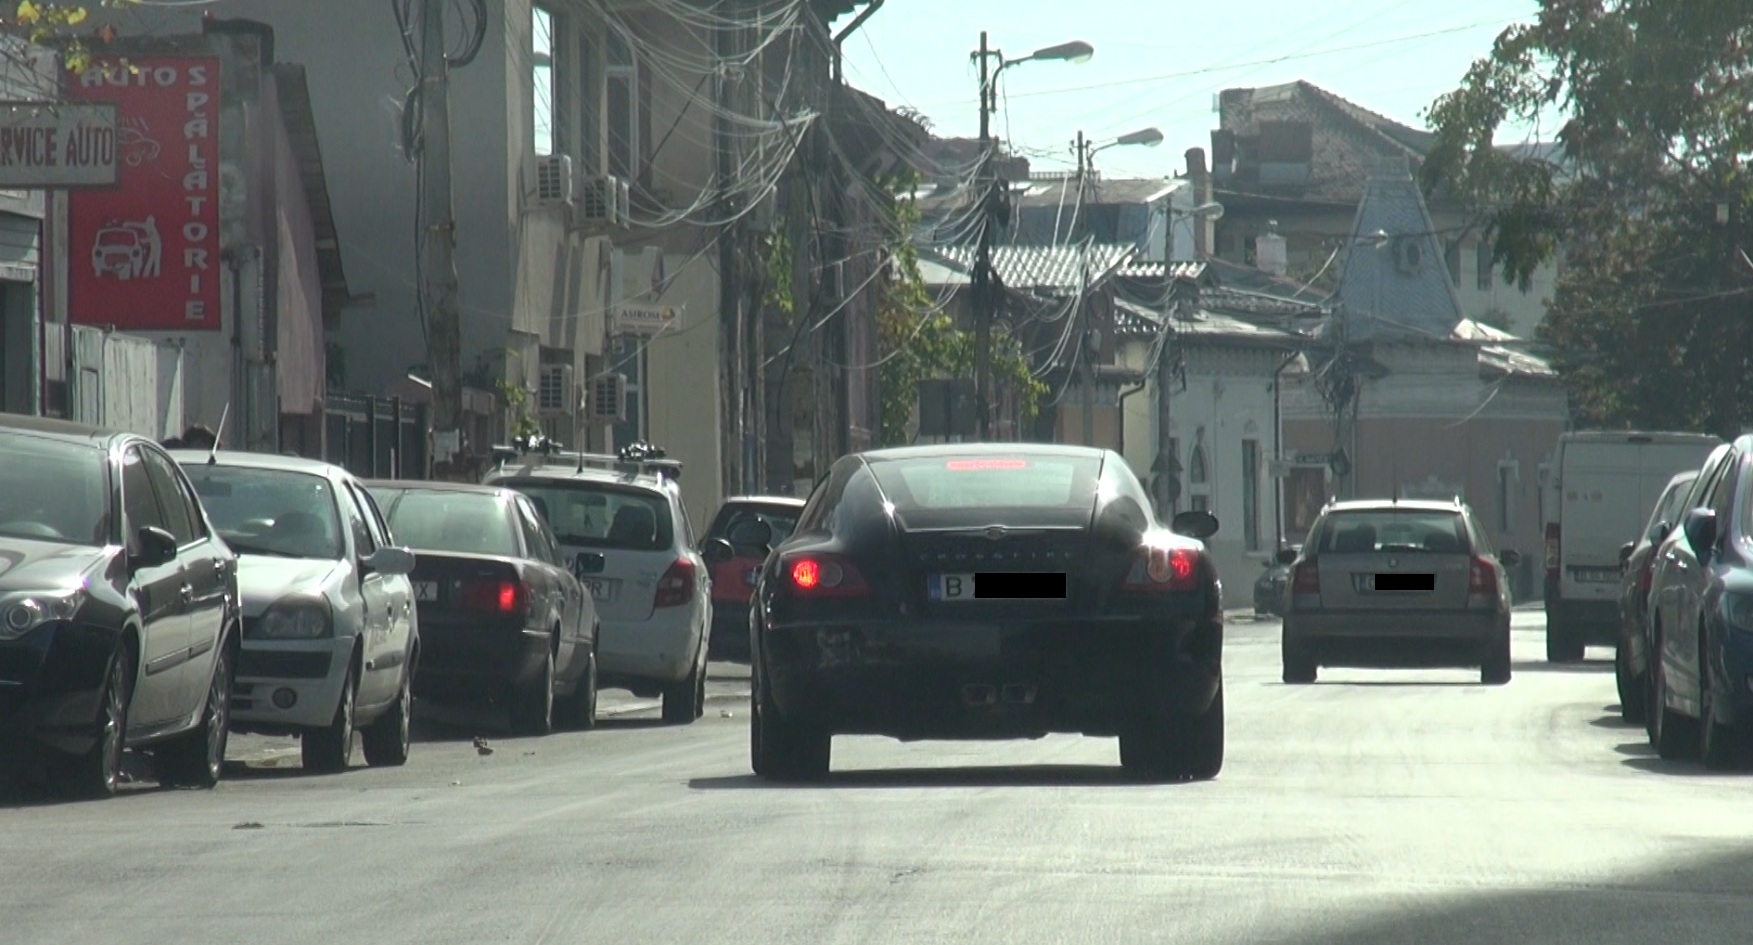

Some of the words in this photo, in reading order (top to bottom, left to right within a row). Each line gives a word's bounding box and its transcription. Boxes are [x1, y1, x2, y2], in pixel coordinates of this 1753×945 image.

[80, 66, 176, 87] AUTO
[65, 127, 113, 168] AUTO
[621, 308, 660, 320] ASIROM
